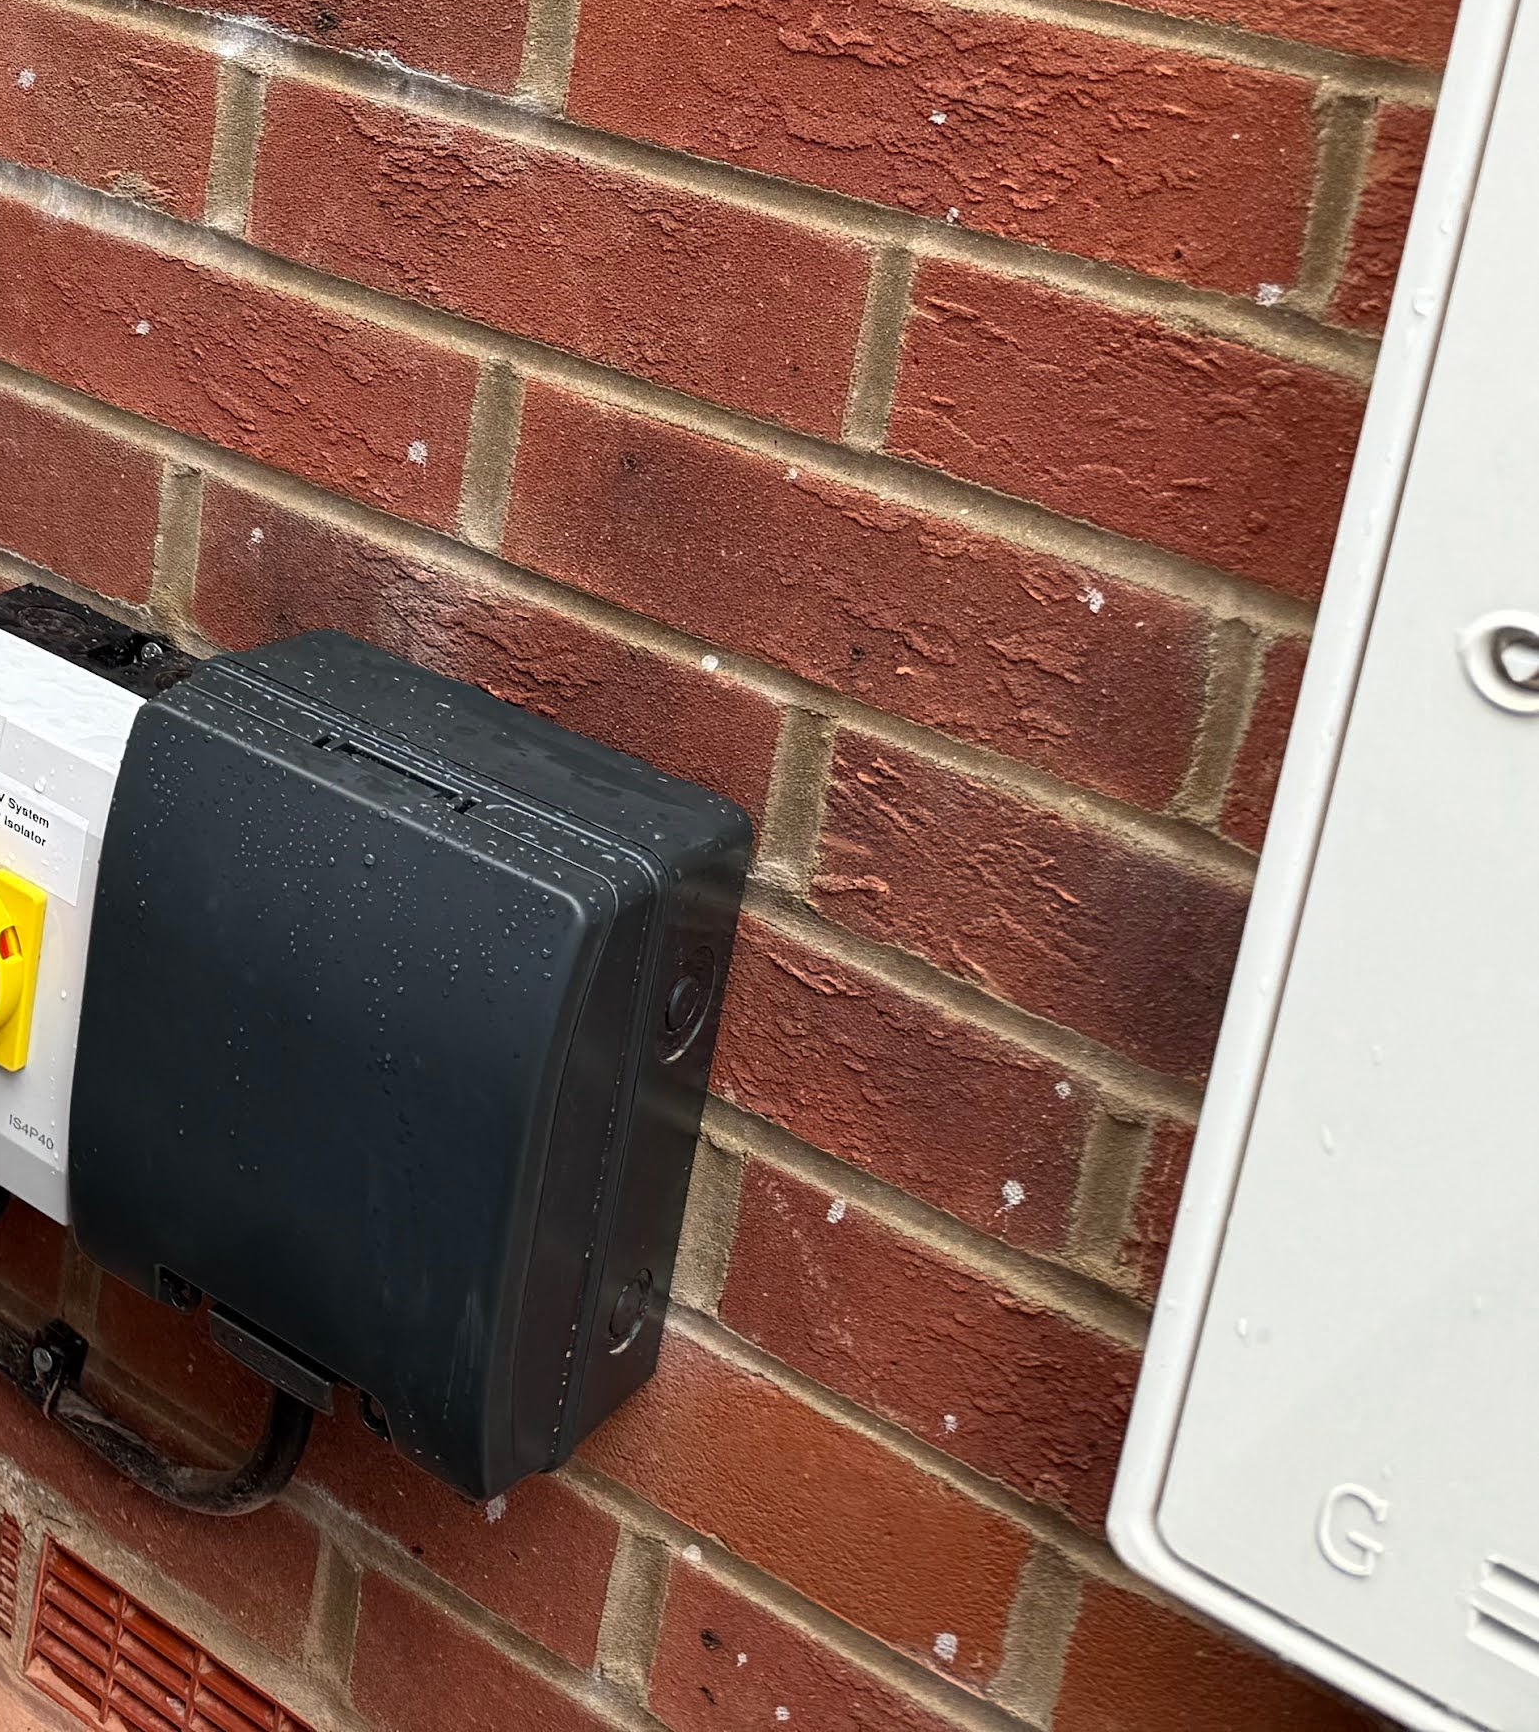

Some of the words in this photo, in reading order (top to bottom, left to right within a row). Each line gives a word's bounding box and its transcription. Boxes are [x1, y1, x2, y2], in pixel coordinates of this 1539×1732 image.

[8, 797, 50, 829] System
[9, 1114, 54, 1150] IS4P40
[1315, 1481, 1392, 1579] G
